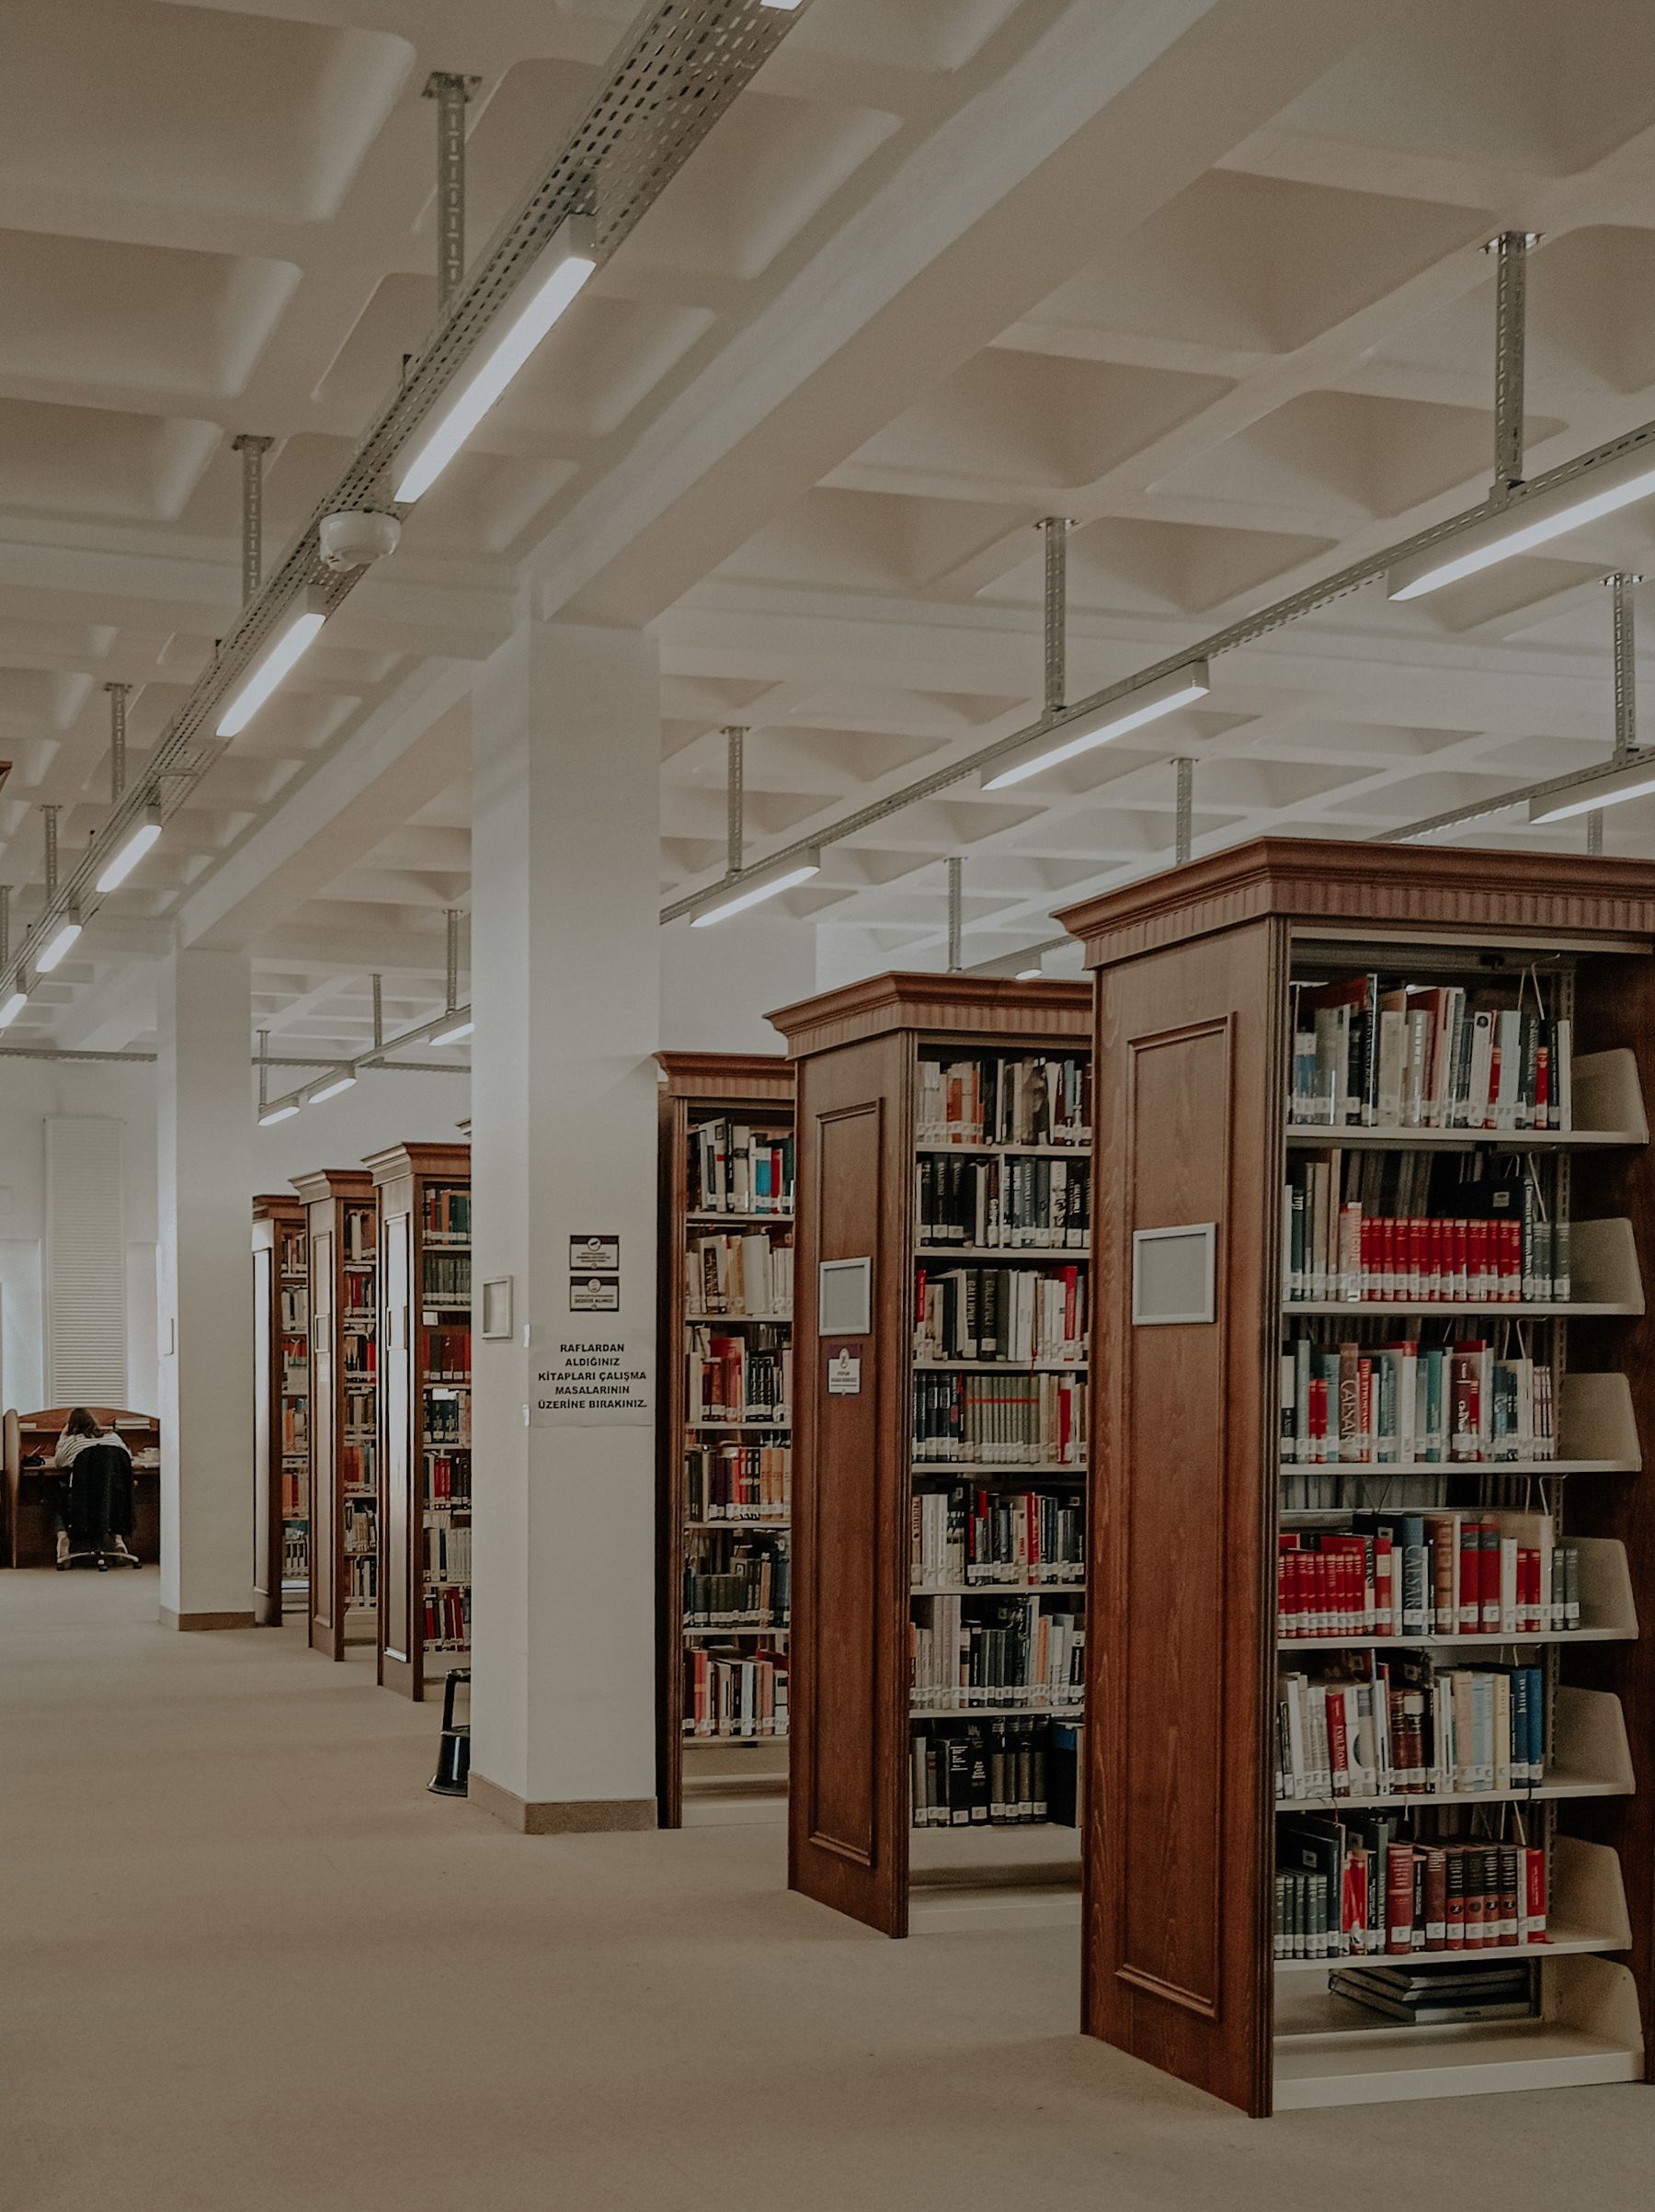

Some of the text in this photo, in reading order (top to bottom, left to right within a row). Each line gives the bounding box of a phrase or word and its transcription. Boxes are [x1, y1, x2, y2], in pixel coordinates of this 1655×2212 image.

[560, 1343, 625, 1352] RAFLARDAN
[565, 1355, 621, 1366] ALDIĞINIZ
[538, 1371, 646, 1382] KİTAPLARI ÇALIŞMA
[554, 1385, 630, 1395] MASALARININ
[538, 1398, 647, 1409] ÜZERİNE BIRAKINIZ.
[1404, 1545, 1422, 1609] CAESAR
